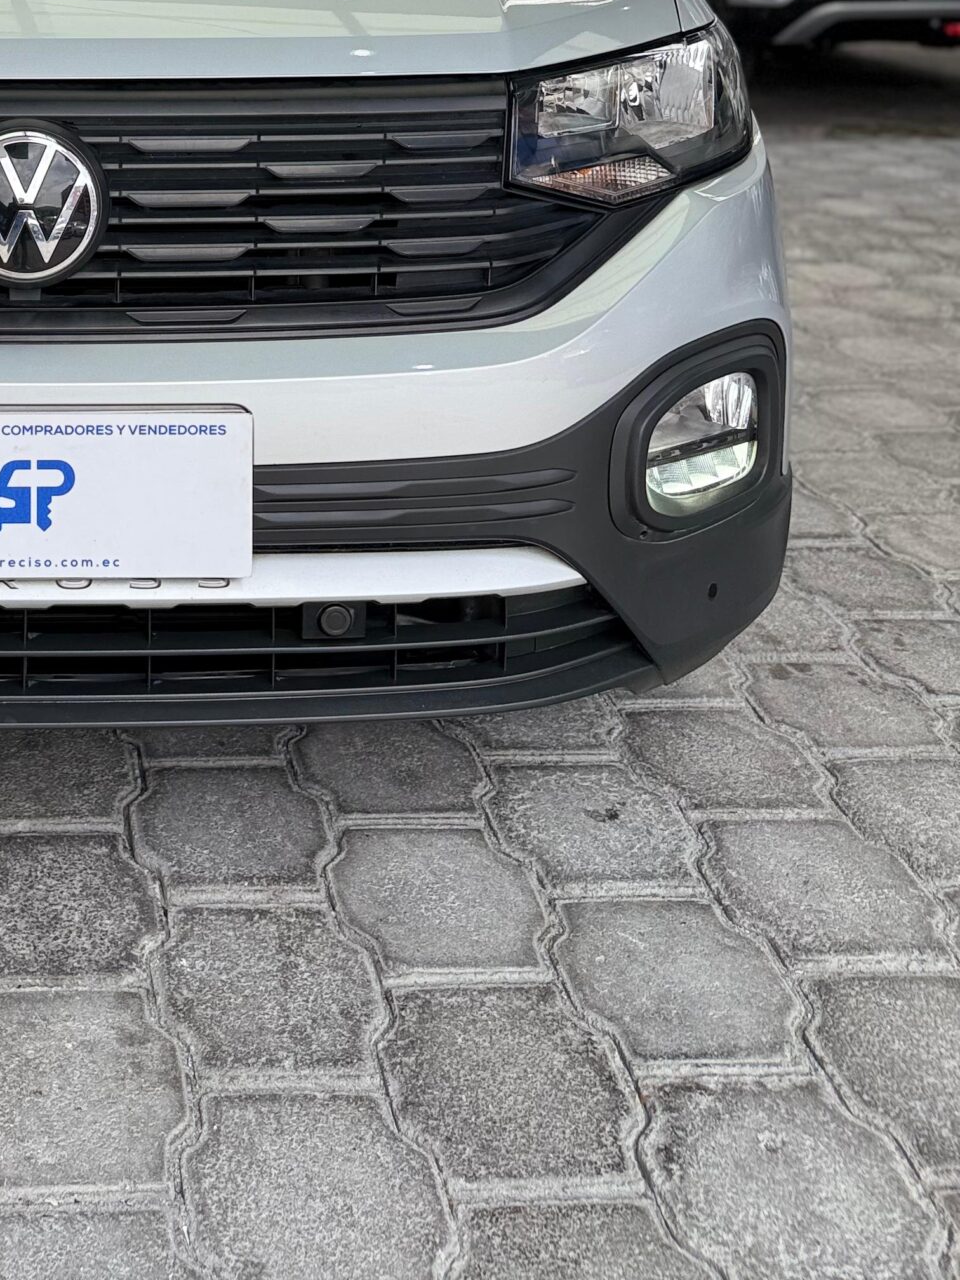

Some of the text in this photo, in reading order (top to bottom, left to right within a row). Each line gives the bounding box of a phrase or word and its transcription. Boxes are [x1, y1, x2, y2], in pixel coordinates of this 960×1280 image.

[1, 424, 114, 436] COMPRADORES
[116, 424, 126, 436] Y
[128, 424, 227, 436] VENDEDORES
